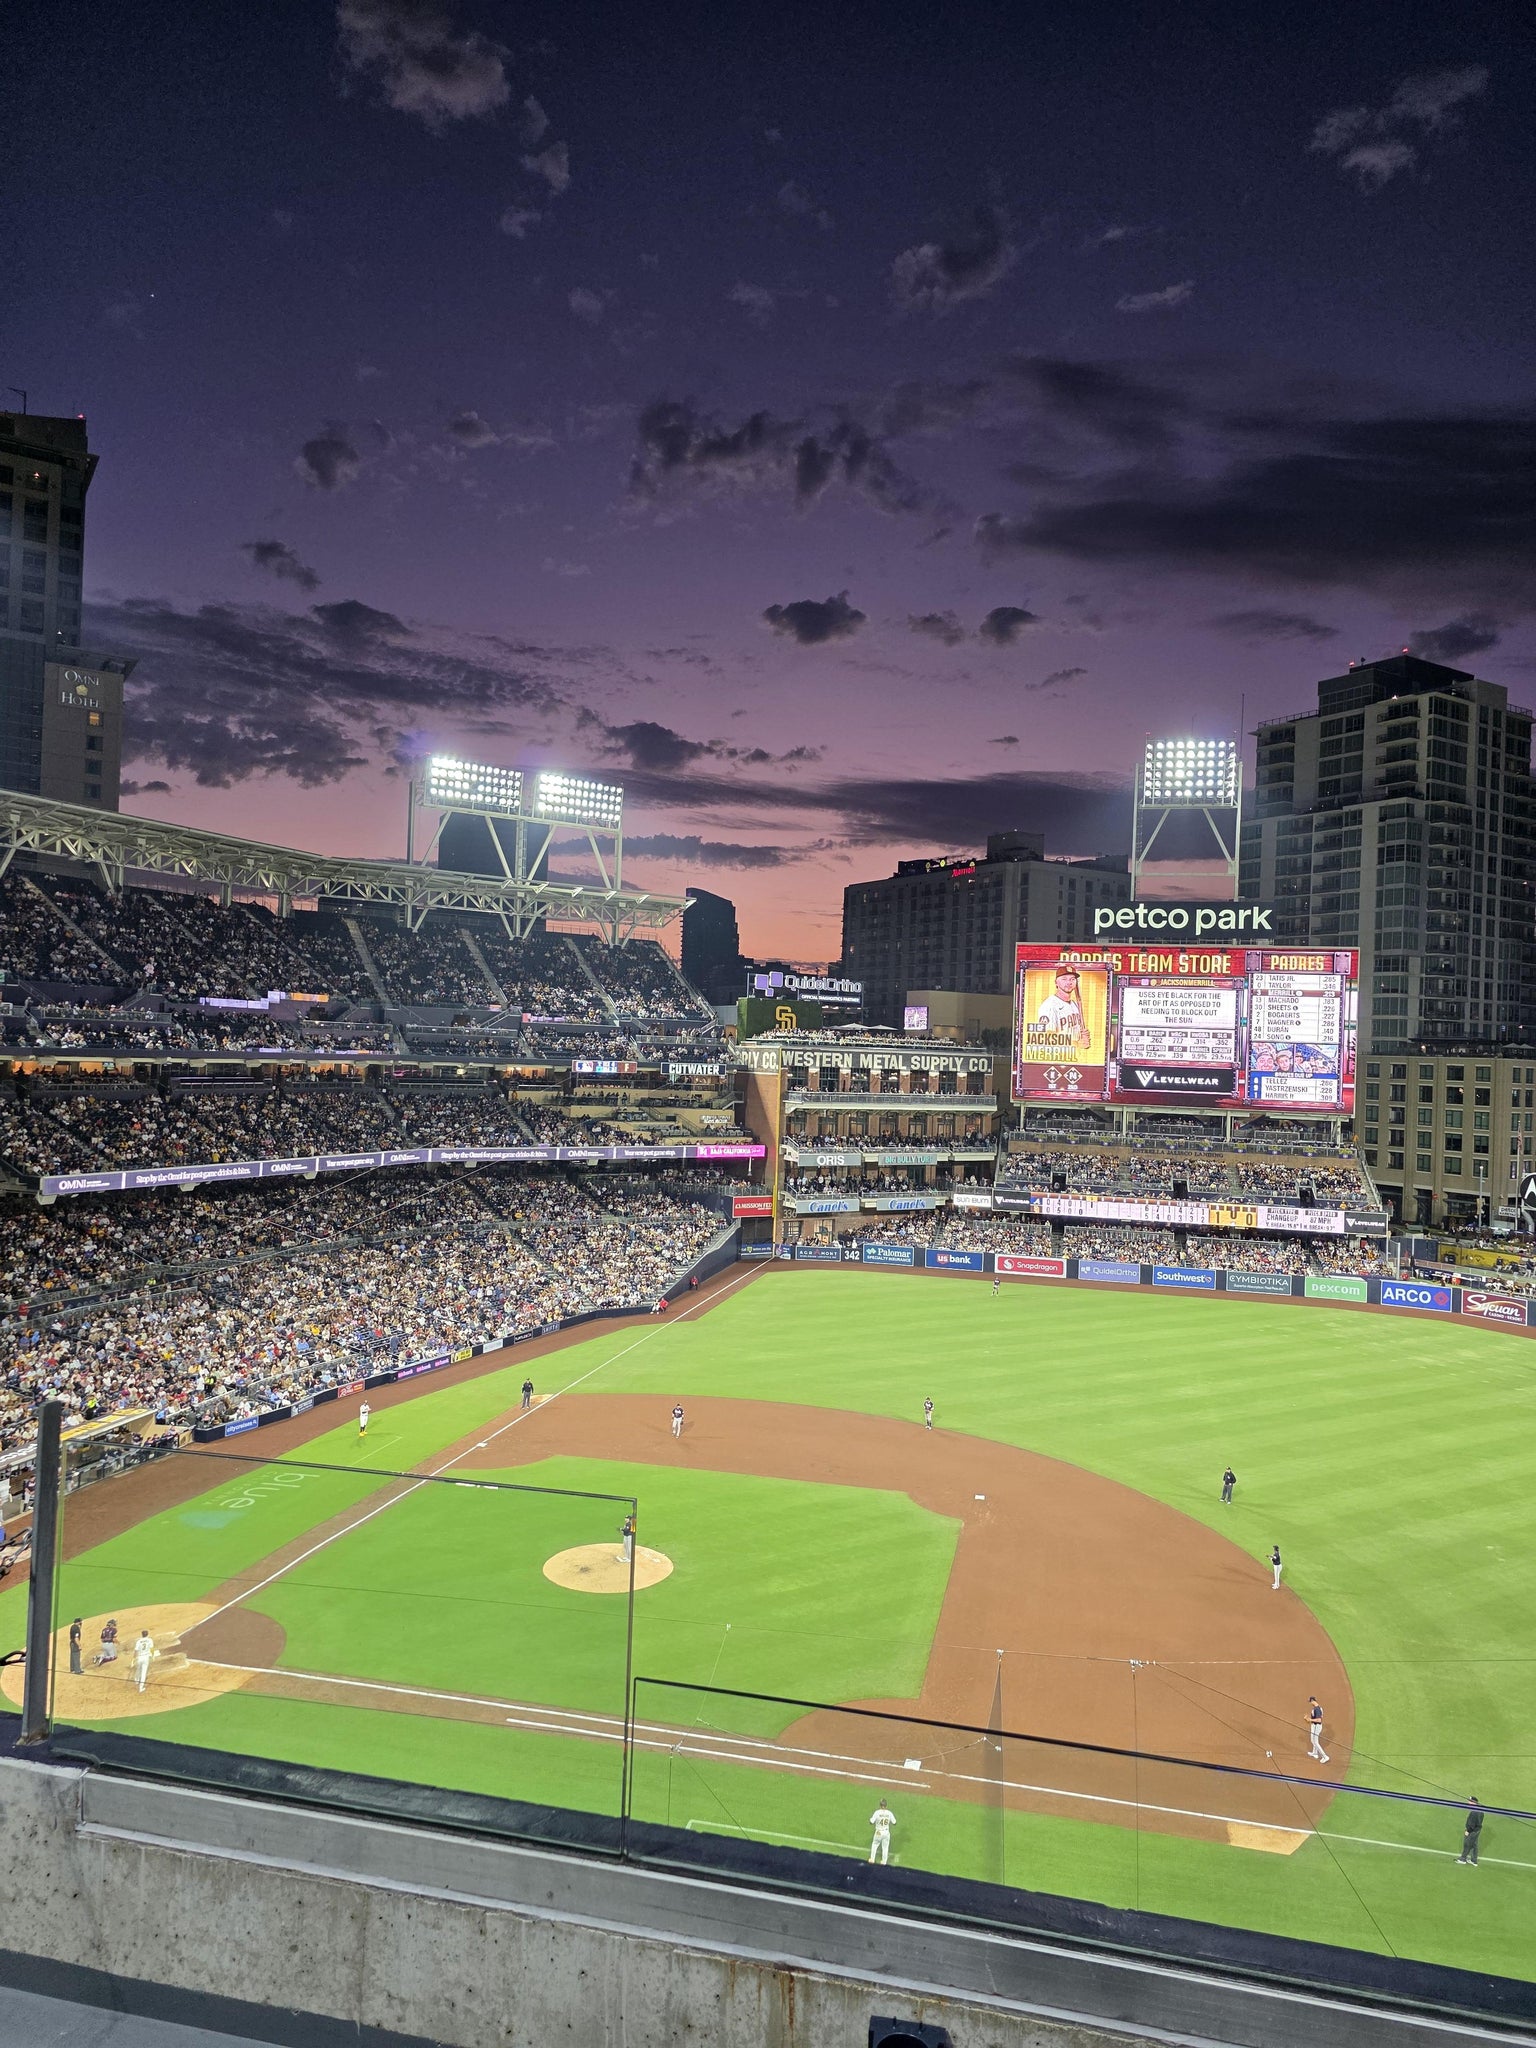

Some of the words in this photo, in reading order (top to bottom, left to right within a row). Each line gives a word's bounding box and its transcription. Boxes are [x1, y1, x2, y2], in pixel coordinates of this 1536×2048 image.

[65, 670, 99, 685] OMNI
[62, 692, 99, 707] HOTEL
[1094, 903, 1189, 934] petco
[1196, 906, 1272, 935] park
[1129, 954, 1173, 972] TEAM
[1179, 955, 1231, 974] STORE
[1271, 956, 1324, 970] PADRES
[785, 975, 861, 993] QuidelOrtho
[1027, 1033, 1072, 1046] JACKSON
[1026, 1045, 1077, 1062] MERRILL
[762, 1051, 779, 1069] CO.
[782, 1050, 853, 1068] WESTERN
[860, 1054, 907, 1070] METAL
[910, 1055, 964, 1071] SUPPLY
[969, 1058, 991, 1072] CO.
[669, 1063, 719, 1074] CUTWATER
[1154, 1076, 1218, 1086] LEVELWEAR
[817, 1155, 845, 1165] ORIS
[271, 1164, 291, 1172] OMNI
[59, 1179, 87, 1190] OMNI
[809, 1201, 848, 1212] Canel's
[889, 1199, 926, 1210] Canel's
[1246, 1214, 1253, 1225] 0
[844, 1251, 860, 1260] 342
[878, 1248, 911, 1257] Palomar
[950, 1255, 971, 1264] bank
[1017, 1261, 1058, 1271] Snapdragon
[1093, 1267, 1137, 1277] QuidelOrtho
[1157, 1272, 1206, 1283] Southwest
[1229, 1275, 1288, 1286] CYMBIOTIKA
[1383, 1287, 1432, 1304] ARCO
[1467, 1294, 1520, 1316] Sycuan
[220, 1472, 320, 1508] blue
